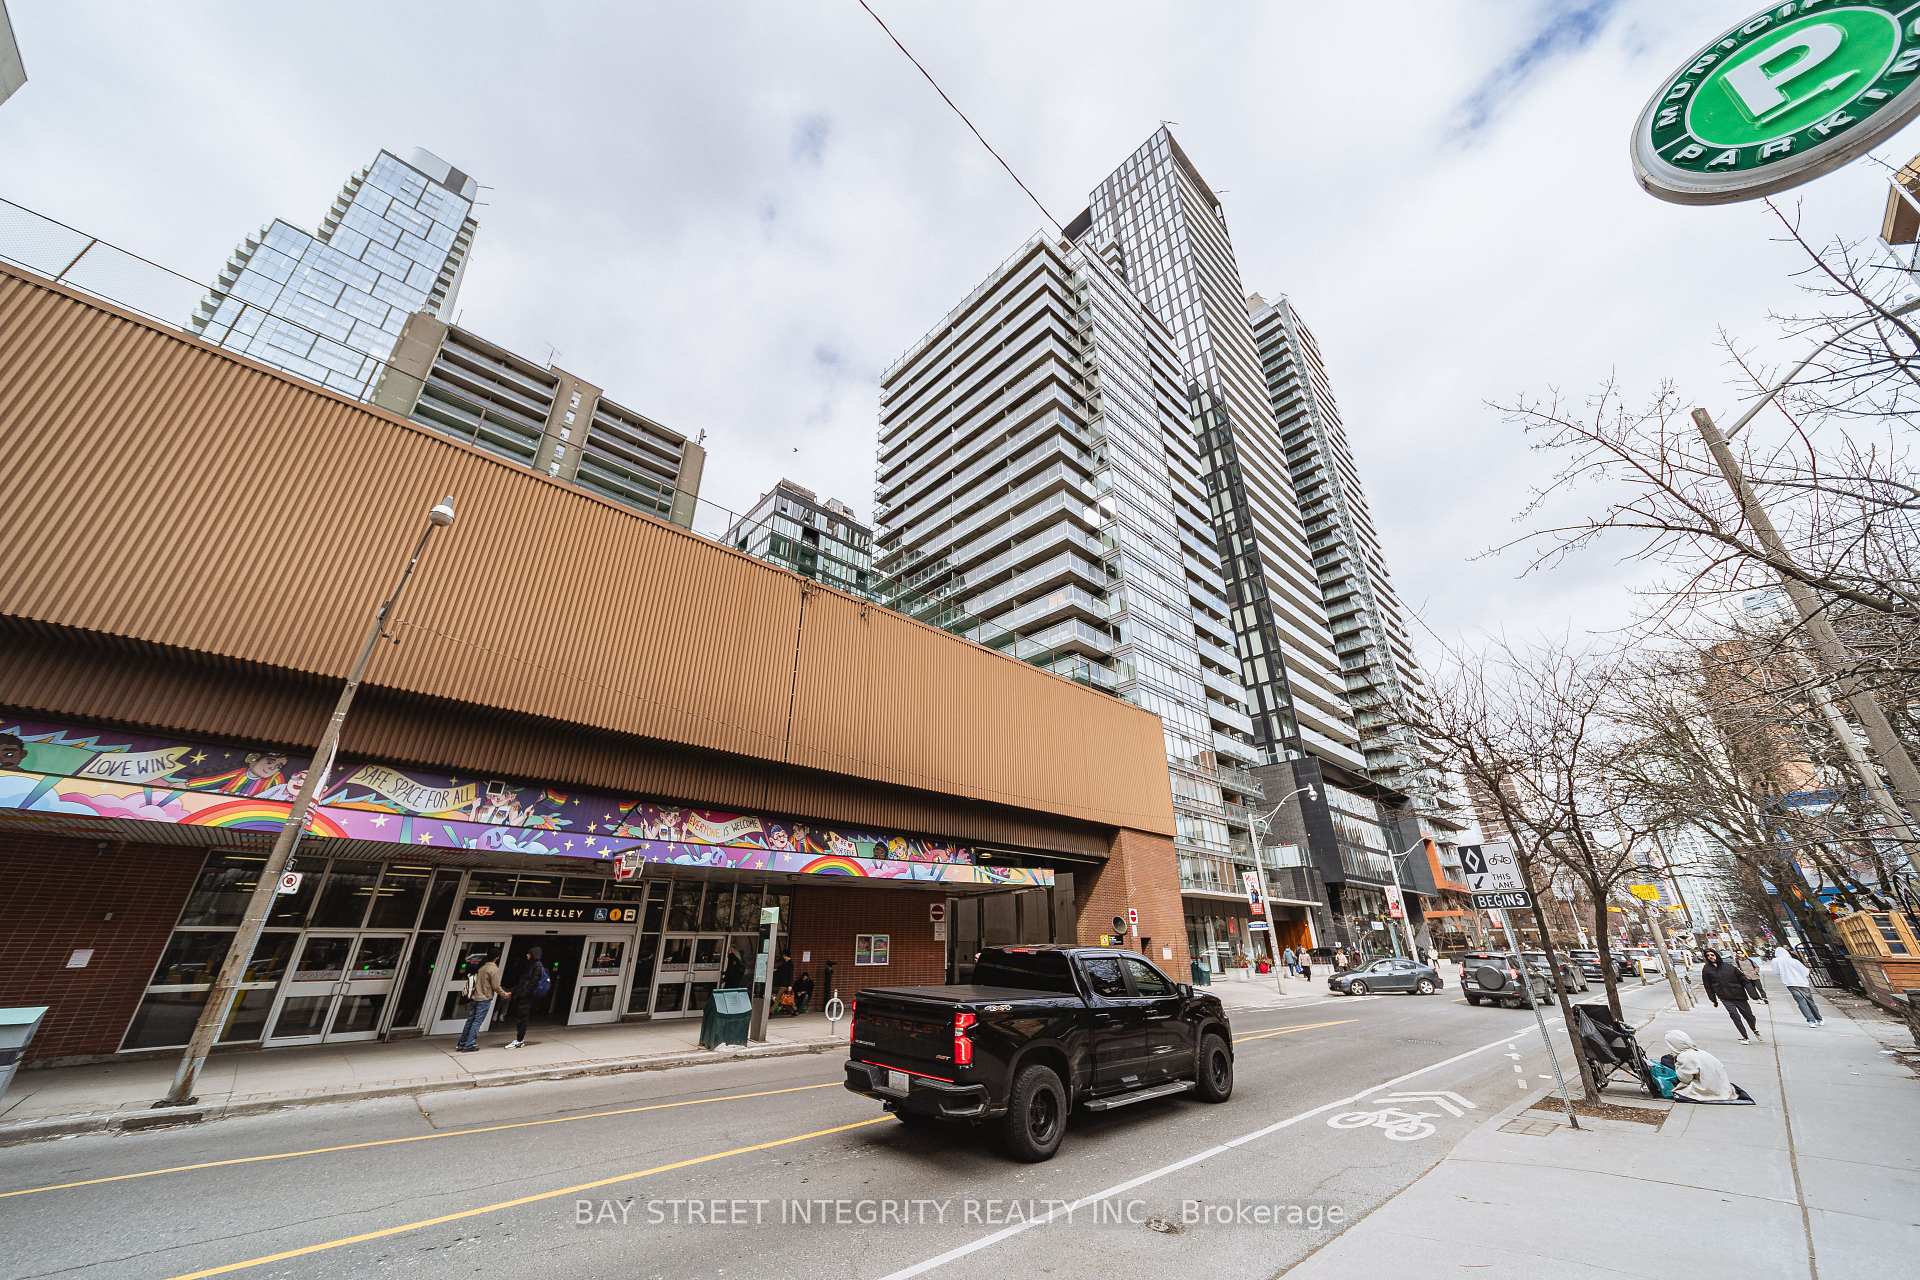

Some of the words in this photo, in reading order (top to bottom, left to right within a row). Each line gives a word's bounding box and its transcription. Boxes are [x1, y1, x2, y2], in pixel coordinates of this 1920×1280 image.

[1723, 23, 1843, 118] P
[1671, 18, 1920, 167] PARKIN
[87, 758, 132, 777] LOVE
[137, 753, 176, 776] WINS
[355, 765, 392, 790] SAFE
[387, 777, 428, 808] SPACE
[425, 790, 450, 809] FOR
[452, 786, 471, 805] ALL
[688, 814, 720, 838] EVERYONE
[723, 825, 730, 837] IS
[731, 818, 758, 833] WELCOME
[1492, 872, 1511, 881] THIS
[1493, 881, 1515, 890] LANE
[1477, 893, 1525, 908] BEGINS
[512, 907, 584, 919] WELLESLEY
